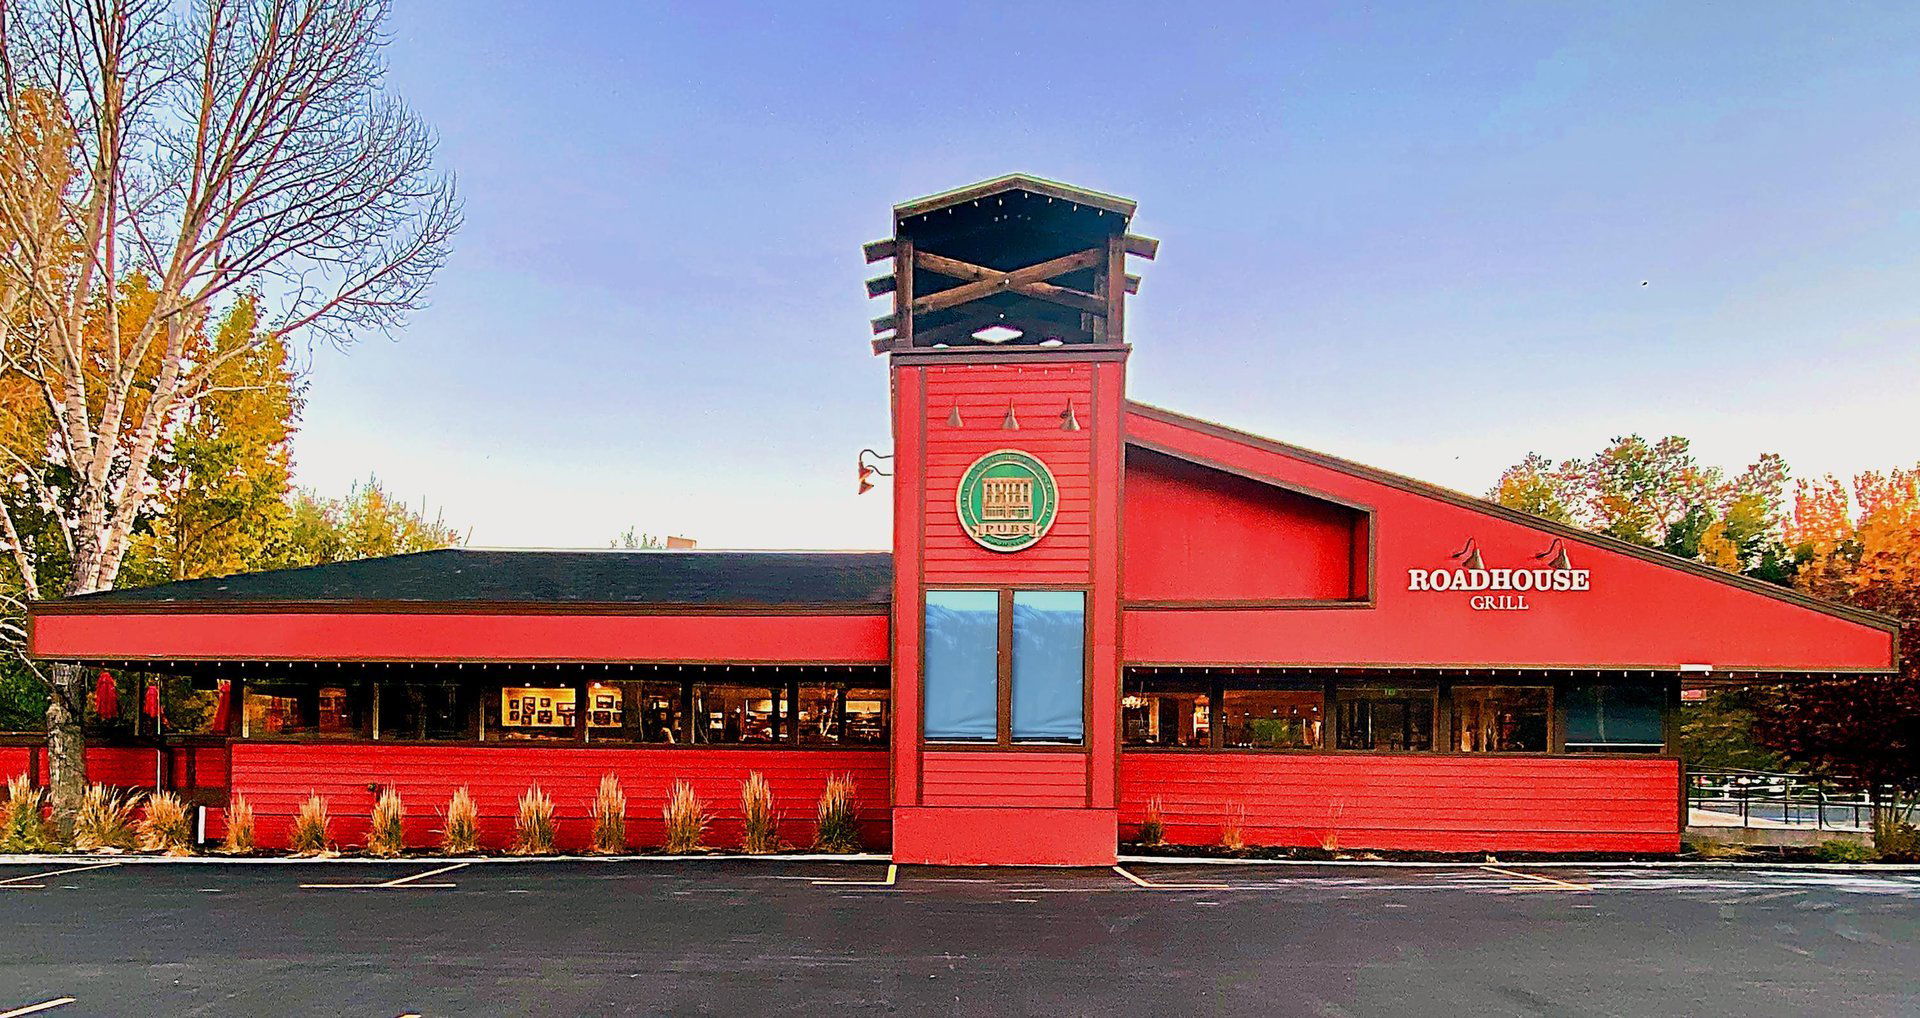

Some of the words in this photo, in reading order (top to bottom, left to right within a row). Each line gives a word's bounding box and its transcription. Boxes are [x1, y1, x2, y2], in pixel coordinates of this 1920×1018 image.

[985, 524, 1030, 533] PUBS
[1408, 569, 1590, 591] ROADHOUSE
[1470, 595, 1529, 610] GRILL
